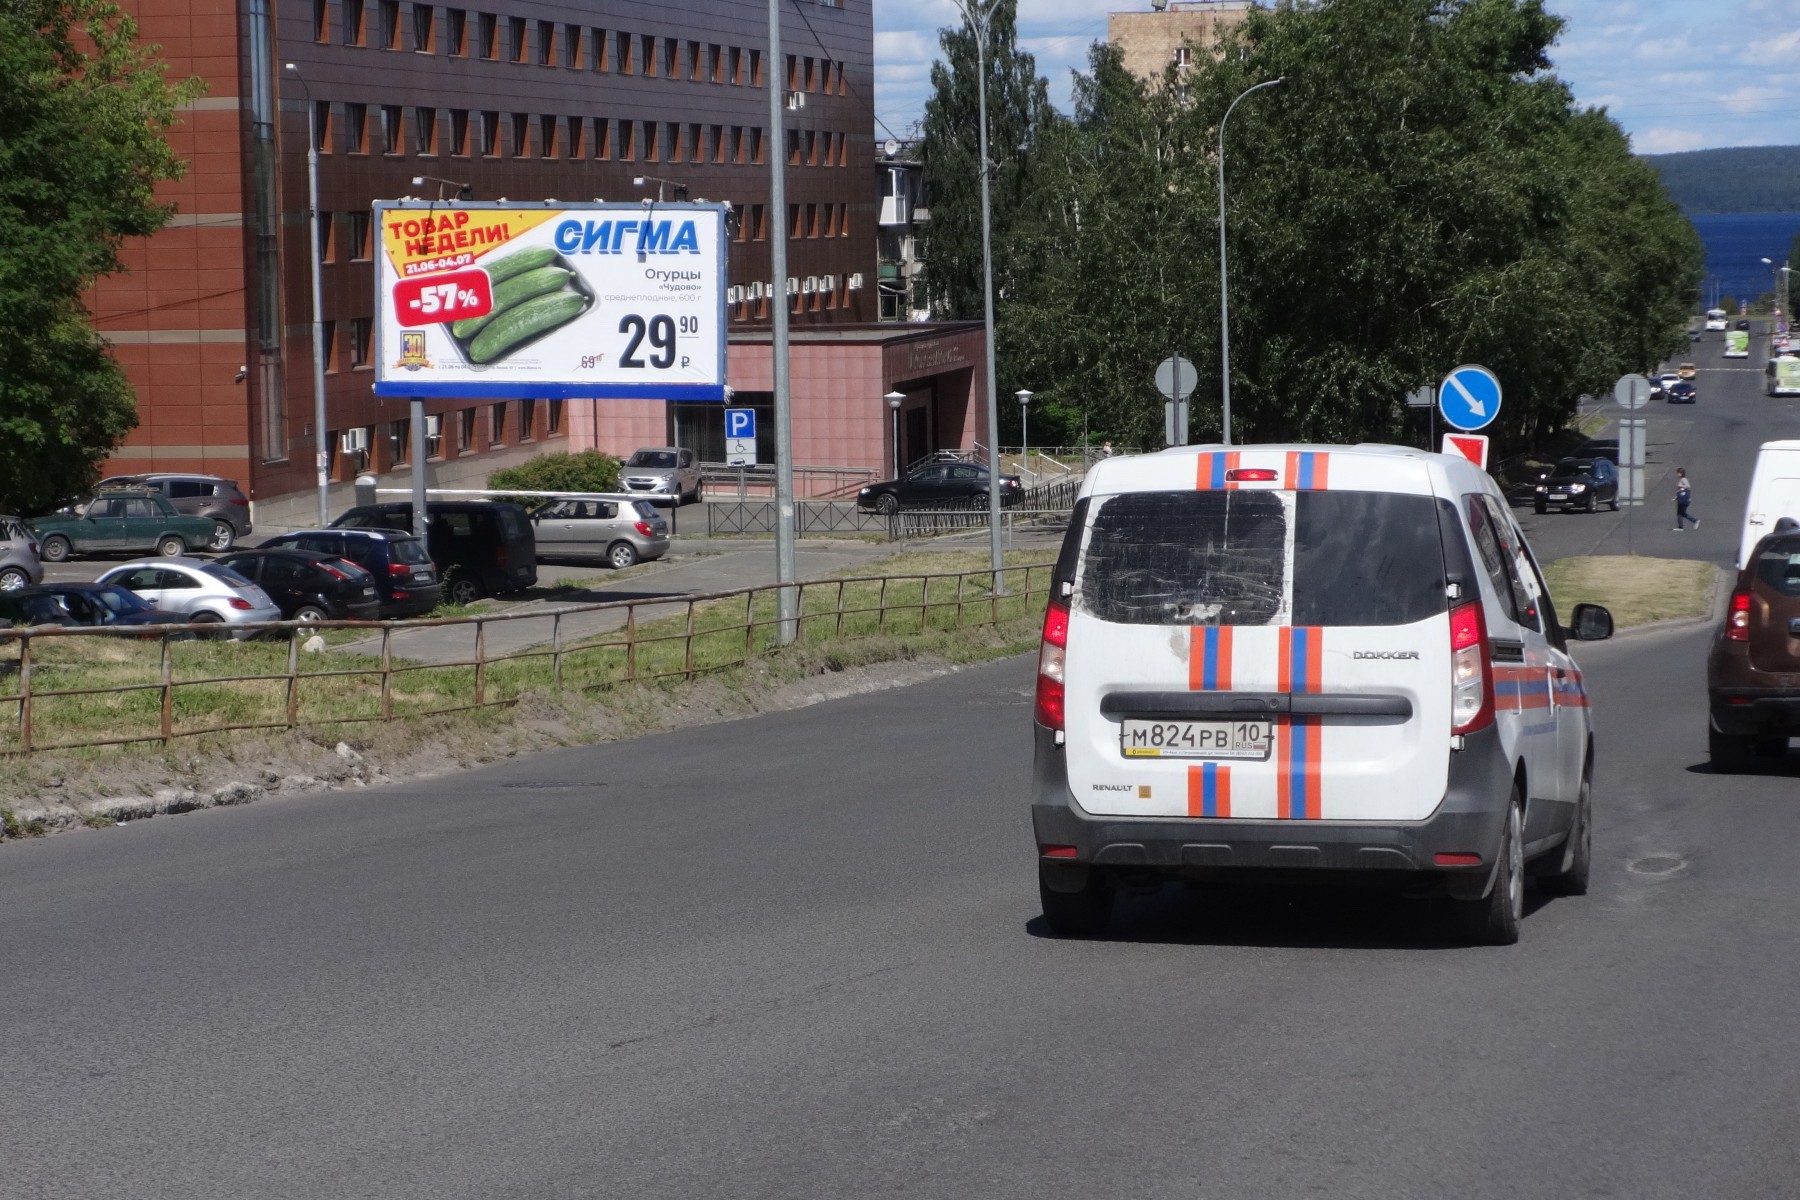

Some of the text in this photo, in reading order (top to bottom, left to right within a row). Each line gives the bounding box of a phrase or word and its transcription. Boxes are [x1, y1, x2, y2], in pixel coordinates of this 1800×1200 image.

[388, 211, 469, 240] ТОВАР
[405, 223, 510, 257] НЕДЕЛИ!
[554, 219, 701, 255] СИГМА
[405, 253, 471, 274] 21.06-04.07
[645, 268, 701, 282] Огурцы
[659, 283, 701, 291] «Чудово»
[409, 282, 479, 314] -57%
[604, 294, 678, 303] среднеплодные,
[679, 294, 696, 302] 600
[618, 313, 698, 369] 29 90
[581, 355, 595, 369] 69
[732, 412, 748, 436] P
[1353, 651, 1420, 660] DOKKER
[1237, 723, 1260, 742] 10
[1235, 741, 1253, 749] RUS
[1092, 784, 1133, 792] RENAULT
